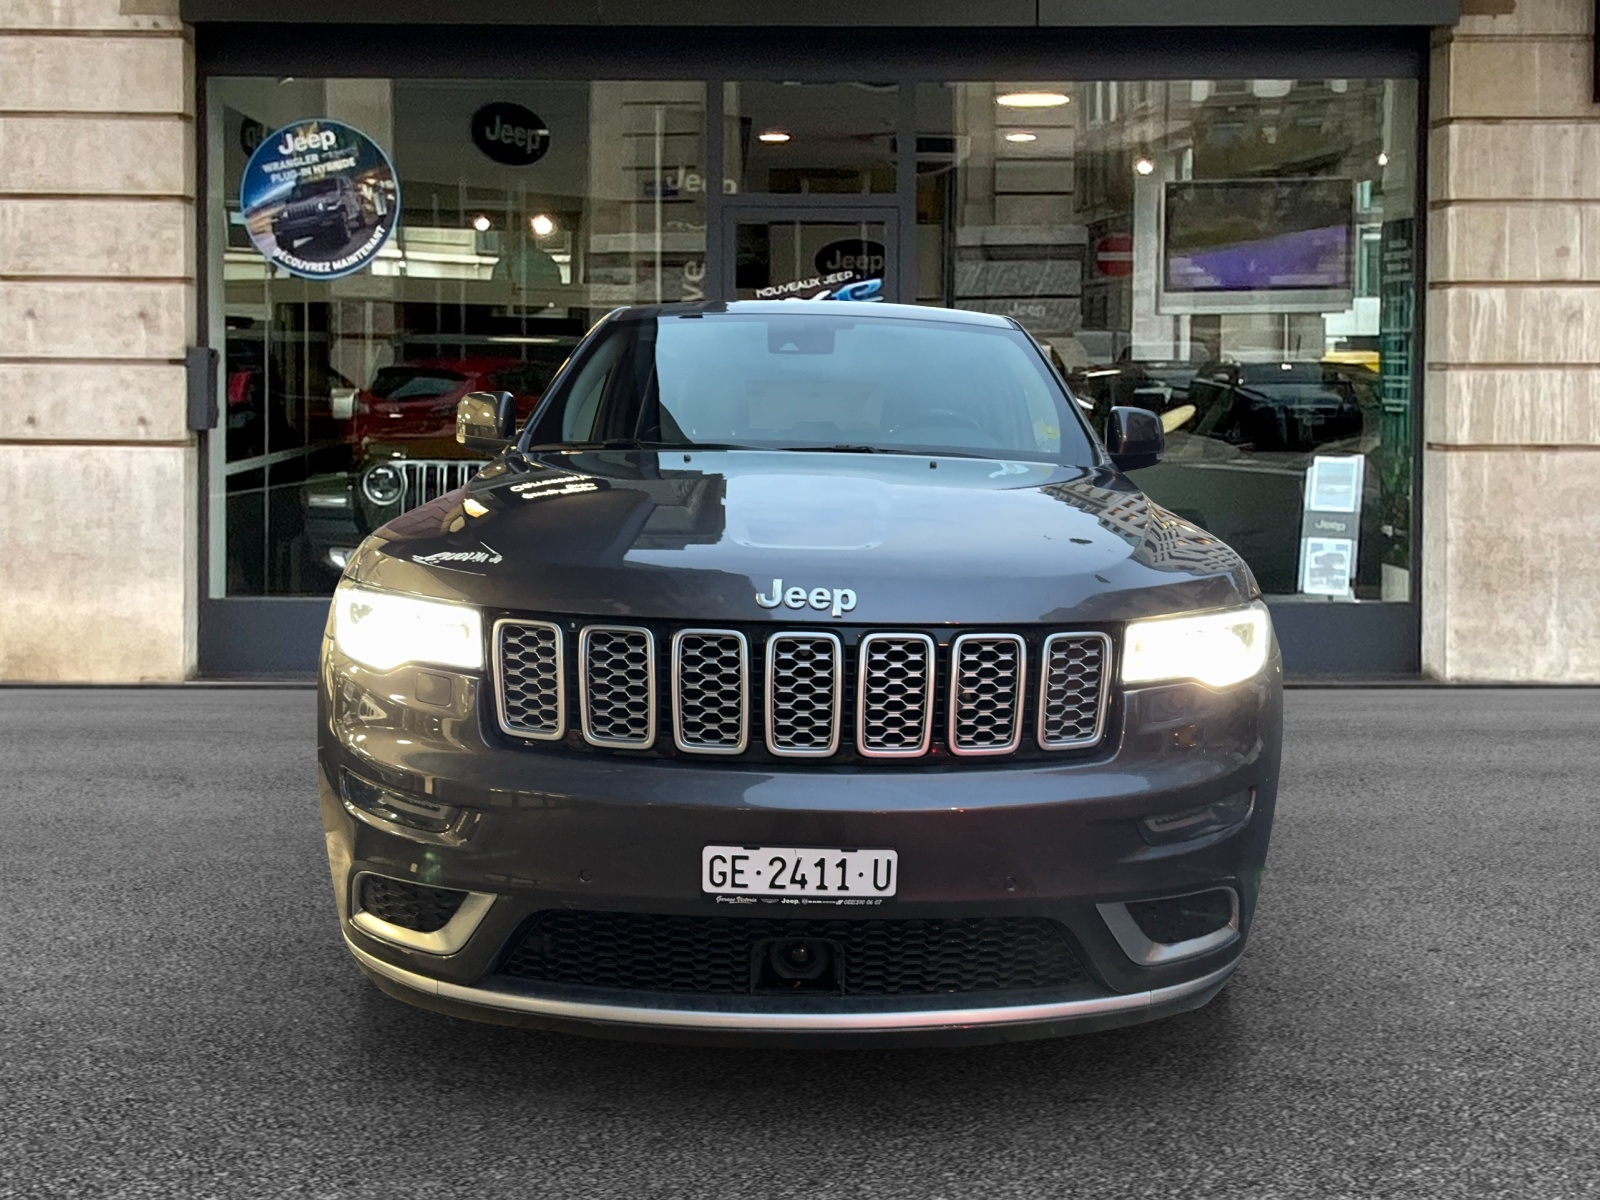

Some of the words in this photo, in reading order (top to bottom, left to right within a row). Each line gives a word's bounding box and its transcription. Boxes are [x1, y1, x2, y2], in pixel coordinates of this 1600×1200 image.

[278, 130, 337, 155] Jeep
[484, 113, 541, 154] Jeep
[262, 153, 320, 173] WRANGLER
[270, 166, 313, 183] PLUG-IN
[332, 225, 386, 271] MAINTENANT
[826, 249, 884, 275] Jeep
[756, 277, 821, 299] NOUVEAUX
[823, 270, 854, 285] JEEP
[1314, 519, 1346, 532] Jeep
[755, 578, 857, 618] Jeep
[781, 897, 799, 905] Jeep
